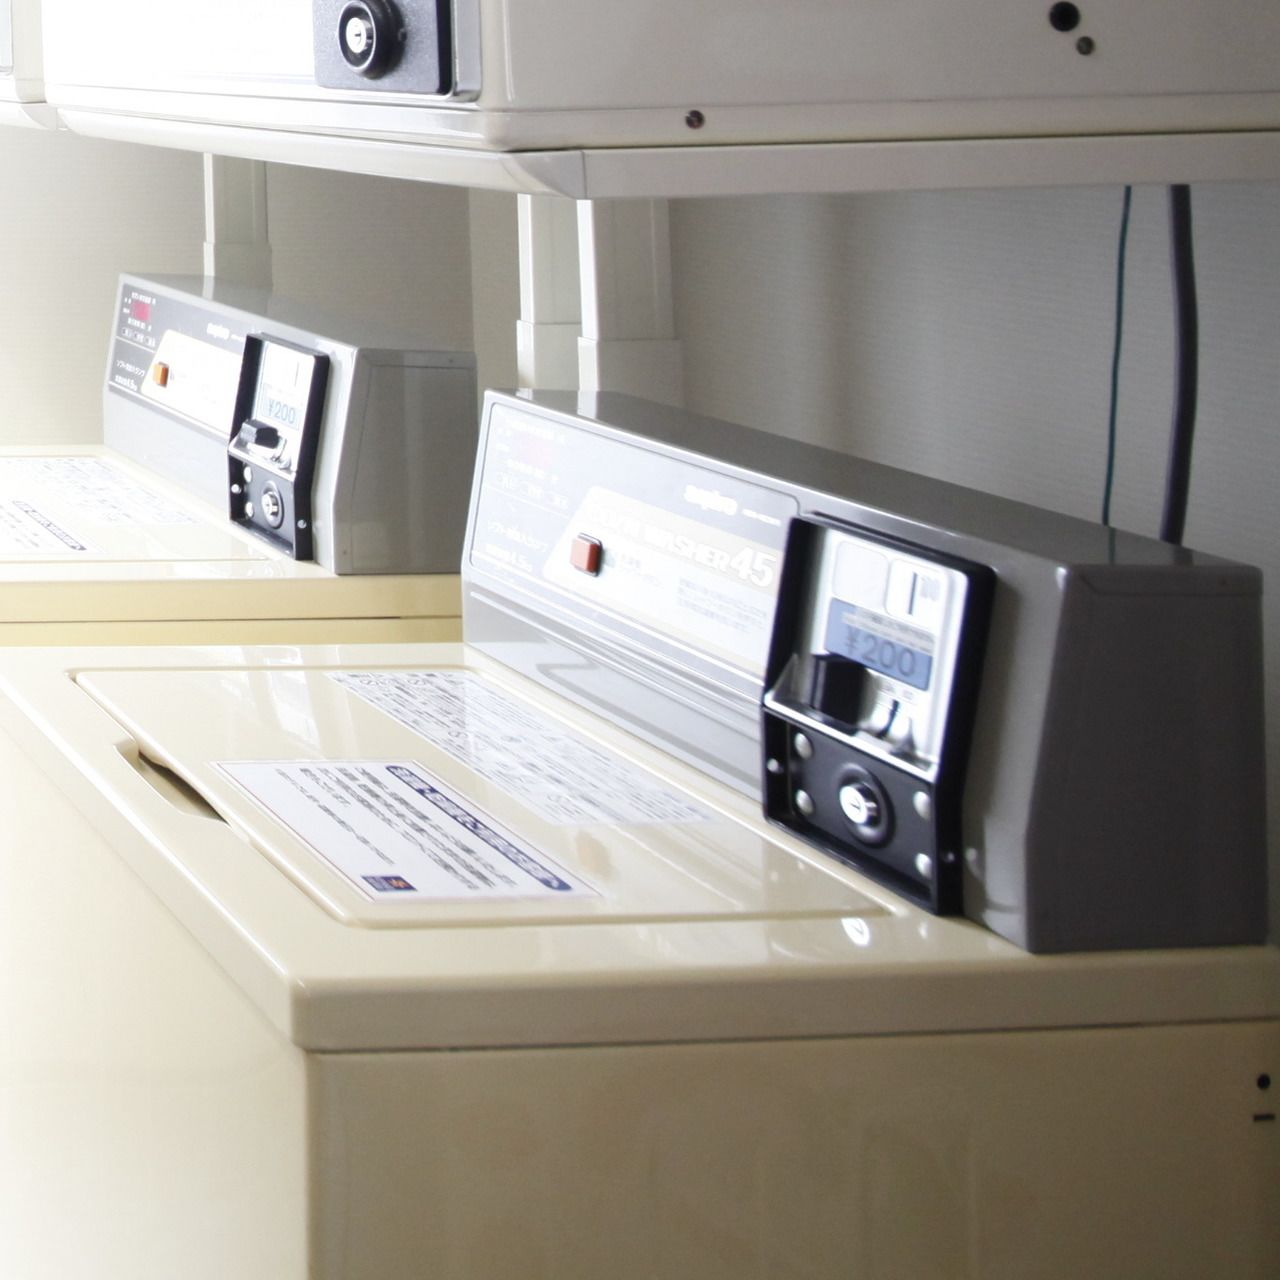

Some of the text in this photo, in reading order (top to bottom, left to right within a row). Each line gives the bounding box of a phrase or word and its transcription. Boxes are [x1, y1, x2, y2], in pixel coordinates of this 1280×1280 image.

[267, 396, 297, 425] ¥200
[729, 545, 776, 588] 45
[844, 624, 916, 677] ¥200
